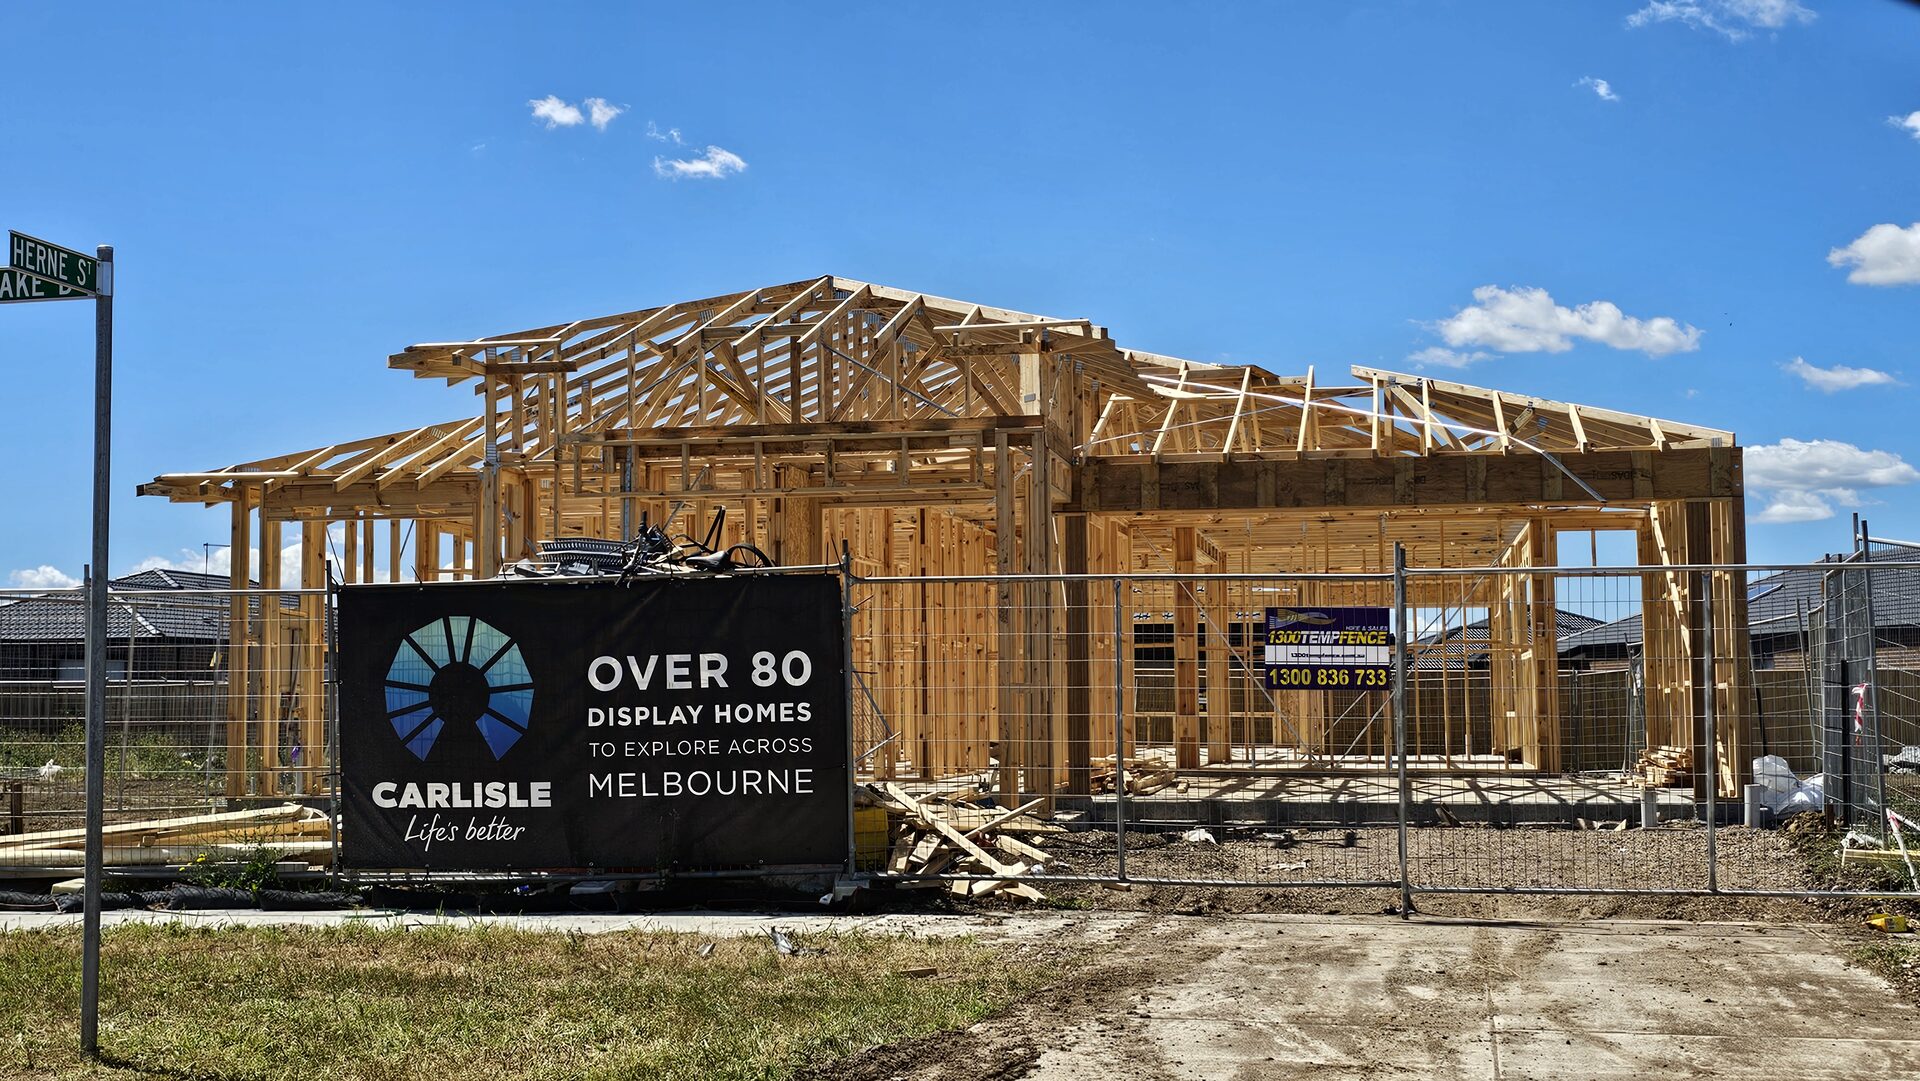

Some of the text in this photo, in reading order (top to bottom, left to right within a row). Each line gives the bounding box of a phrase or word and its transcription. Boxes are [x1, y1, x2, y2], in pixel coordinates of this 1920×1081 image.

[13, 236, 68, 280] HERNE
[587, 650, 812, 692] OVER 80
[1269, 668, 1387, 686] 1300 836 733
[588, 702, 812, 727] DISPLAY HOMES
[588, 738, 813, 757] TO EXPLORE ACROSS
[371, 781, 552, 808] CARLISLE
[589, 769, 814, 798] MELBOURNE
[404, 813, 526, 852] Life's better
